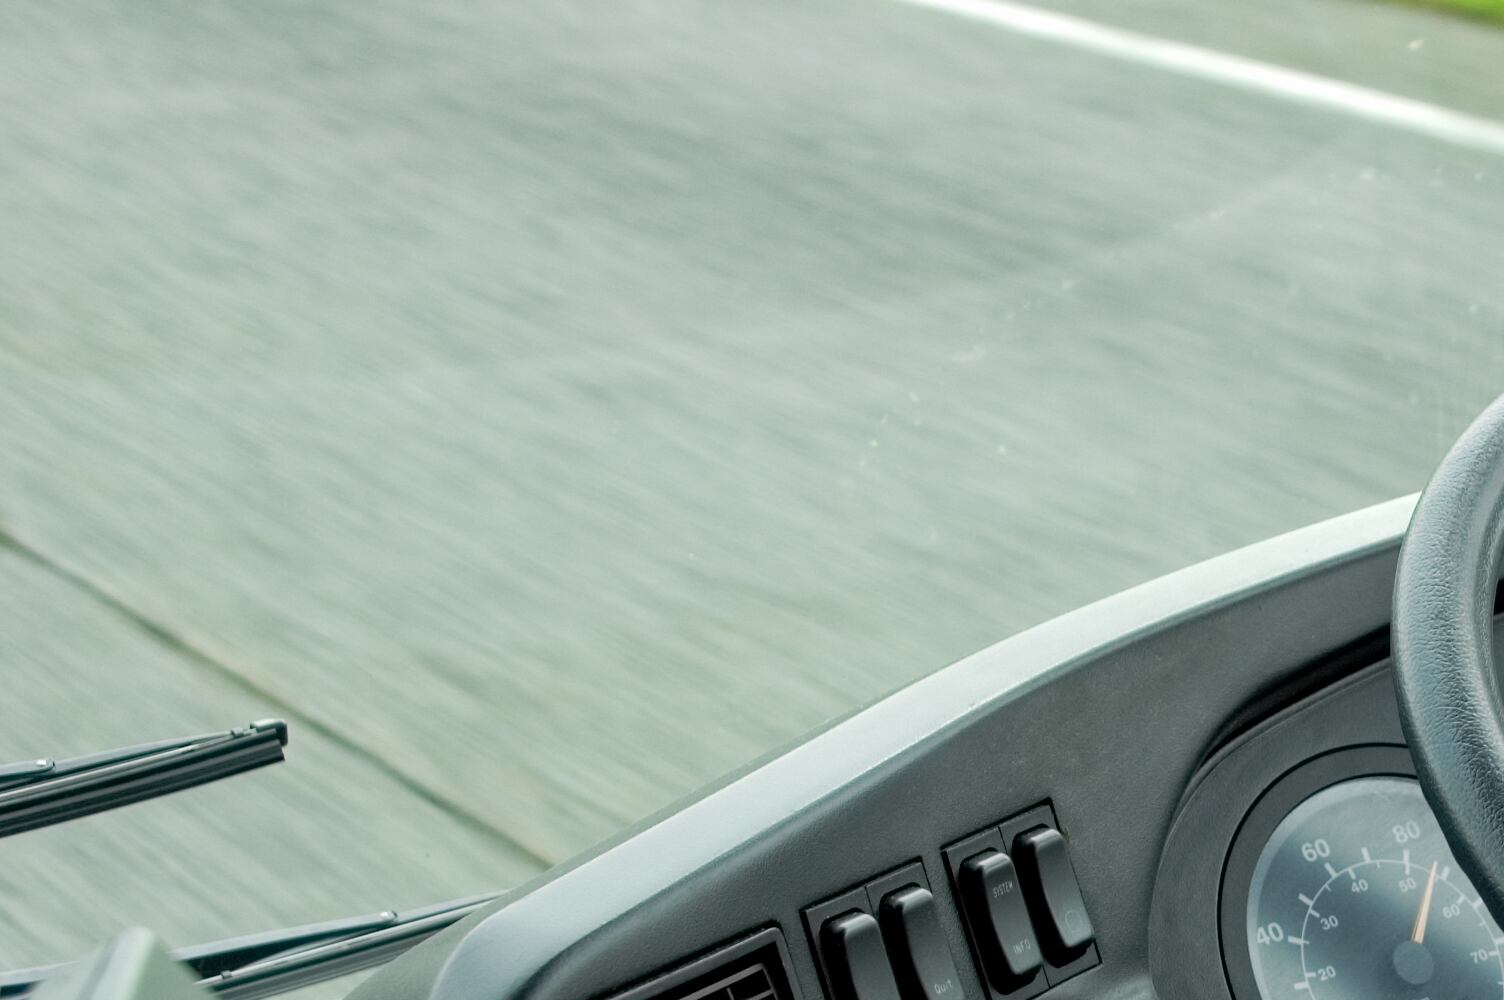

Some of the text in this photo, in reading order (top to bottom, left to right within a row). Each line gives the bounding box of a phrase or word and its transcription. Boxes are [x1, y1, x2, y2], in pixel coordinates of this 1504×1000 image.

[1392, 820, 1421, 843] 80
[1301, 838, 1330, 862] 60
[992, 879, 1014, 898] SYSTEM
[1351, 879, 1369, 893] 40
[1398, 877, 1417, 892] 50
[1442, 903, 1460, 919] 60
[1320, 915, 1338, 930] 30
[1256, 922, 1284, 945] 40
[1013, 939, 1031, 954] INFO
[1469, 948, 1489, 964] 70
[1317, 965, 1336, 981] 20
[934, 979, 953, 995] Quit
